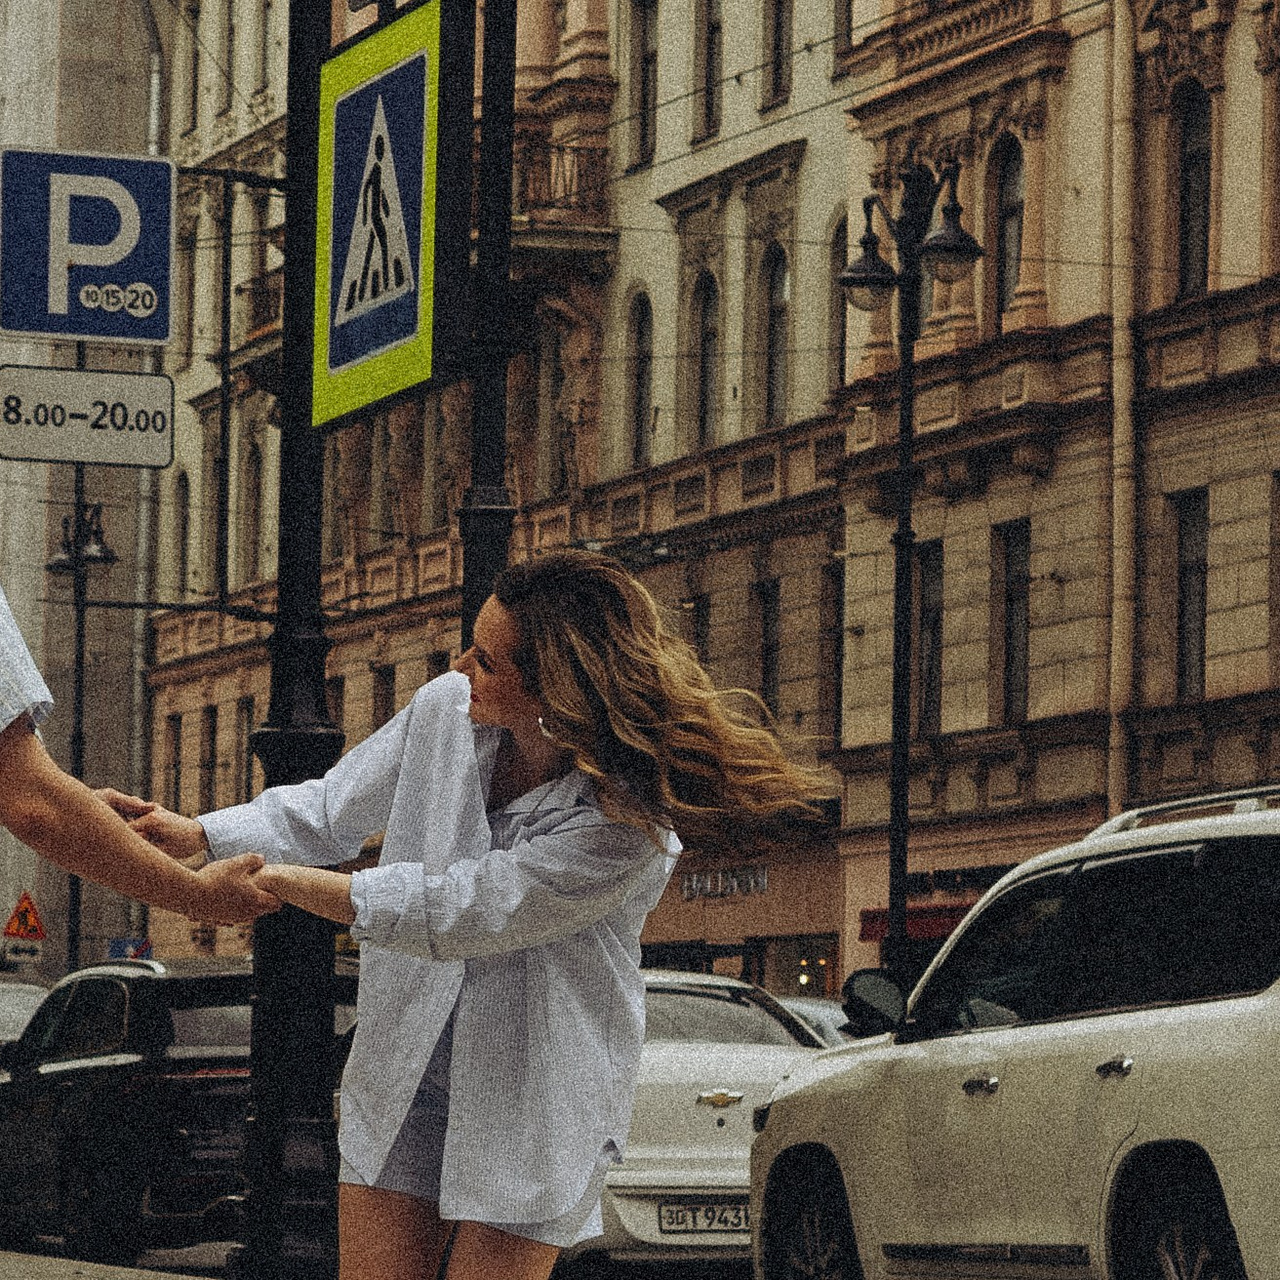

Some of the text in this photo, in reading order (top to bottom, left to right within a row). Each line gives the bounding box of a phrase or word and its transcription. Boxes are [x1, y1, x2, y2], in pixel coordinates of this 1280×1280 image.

[48, 173, 142, 315] P
[84, 288, 155, 310] 10 15 20
